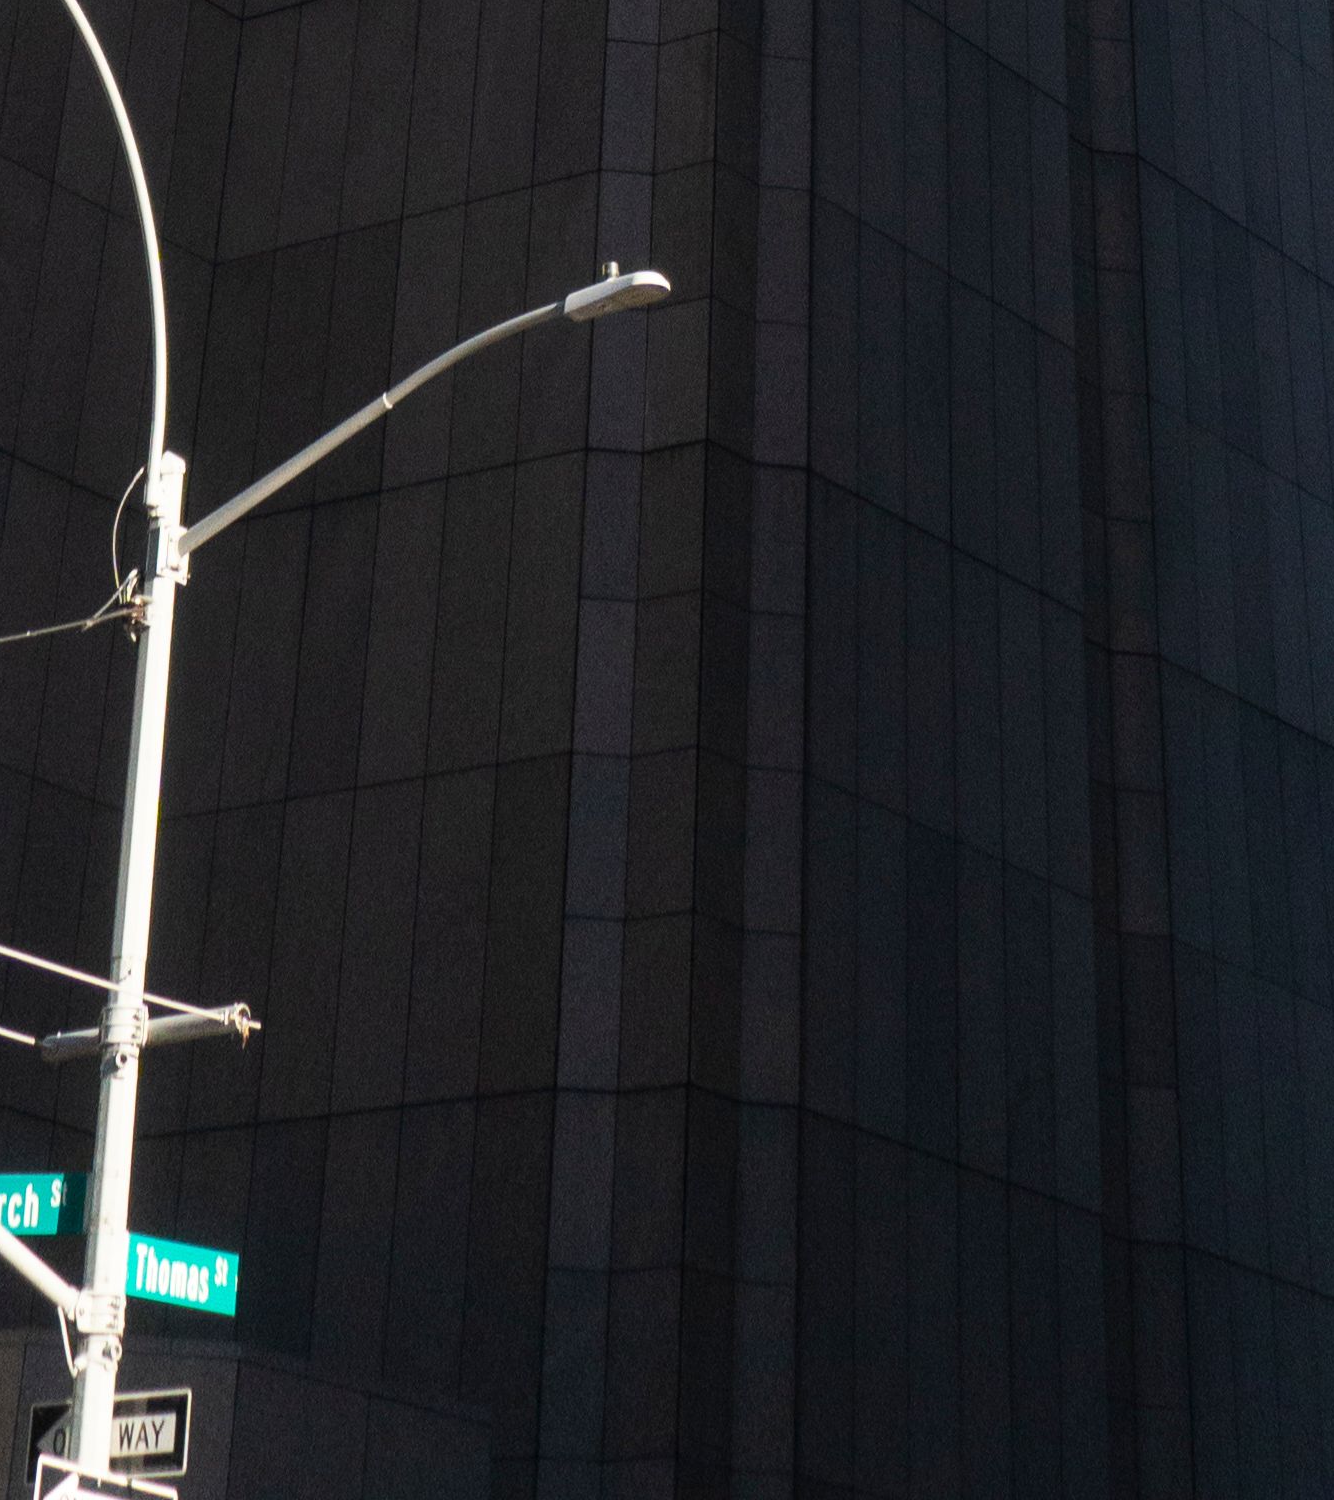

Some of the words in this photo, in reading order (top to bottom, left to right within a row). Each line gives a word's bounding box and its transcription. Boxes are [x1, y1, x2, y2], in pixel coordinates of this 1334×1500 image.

[136, 1242, 209, 1304] Thomas
[214, 1254, 229, 1287] St
[119, 1420, 165, 1450] WAY
